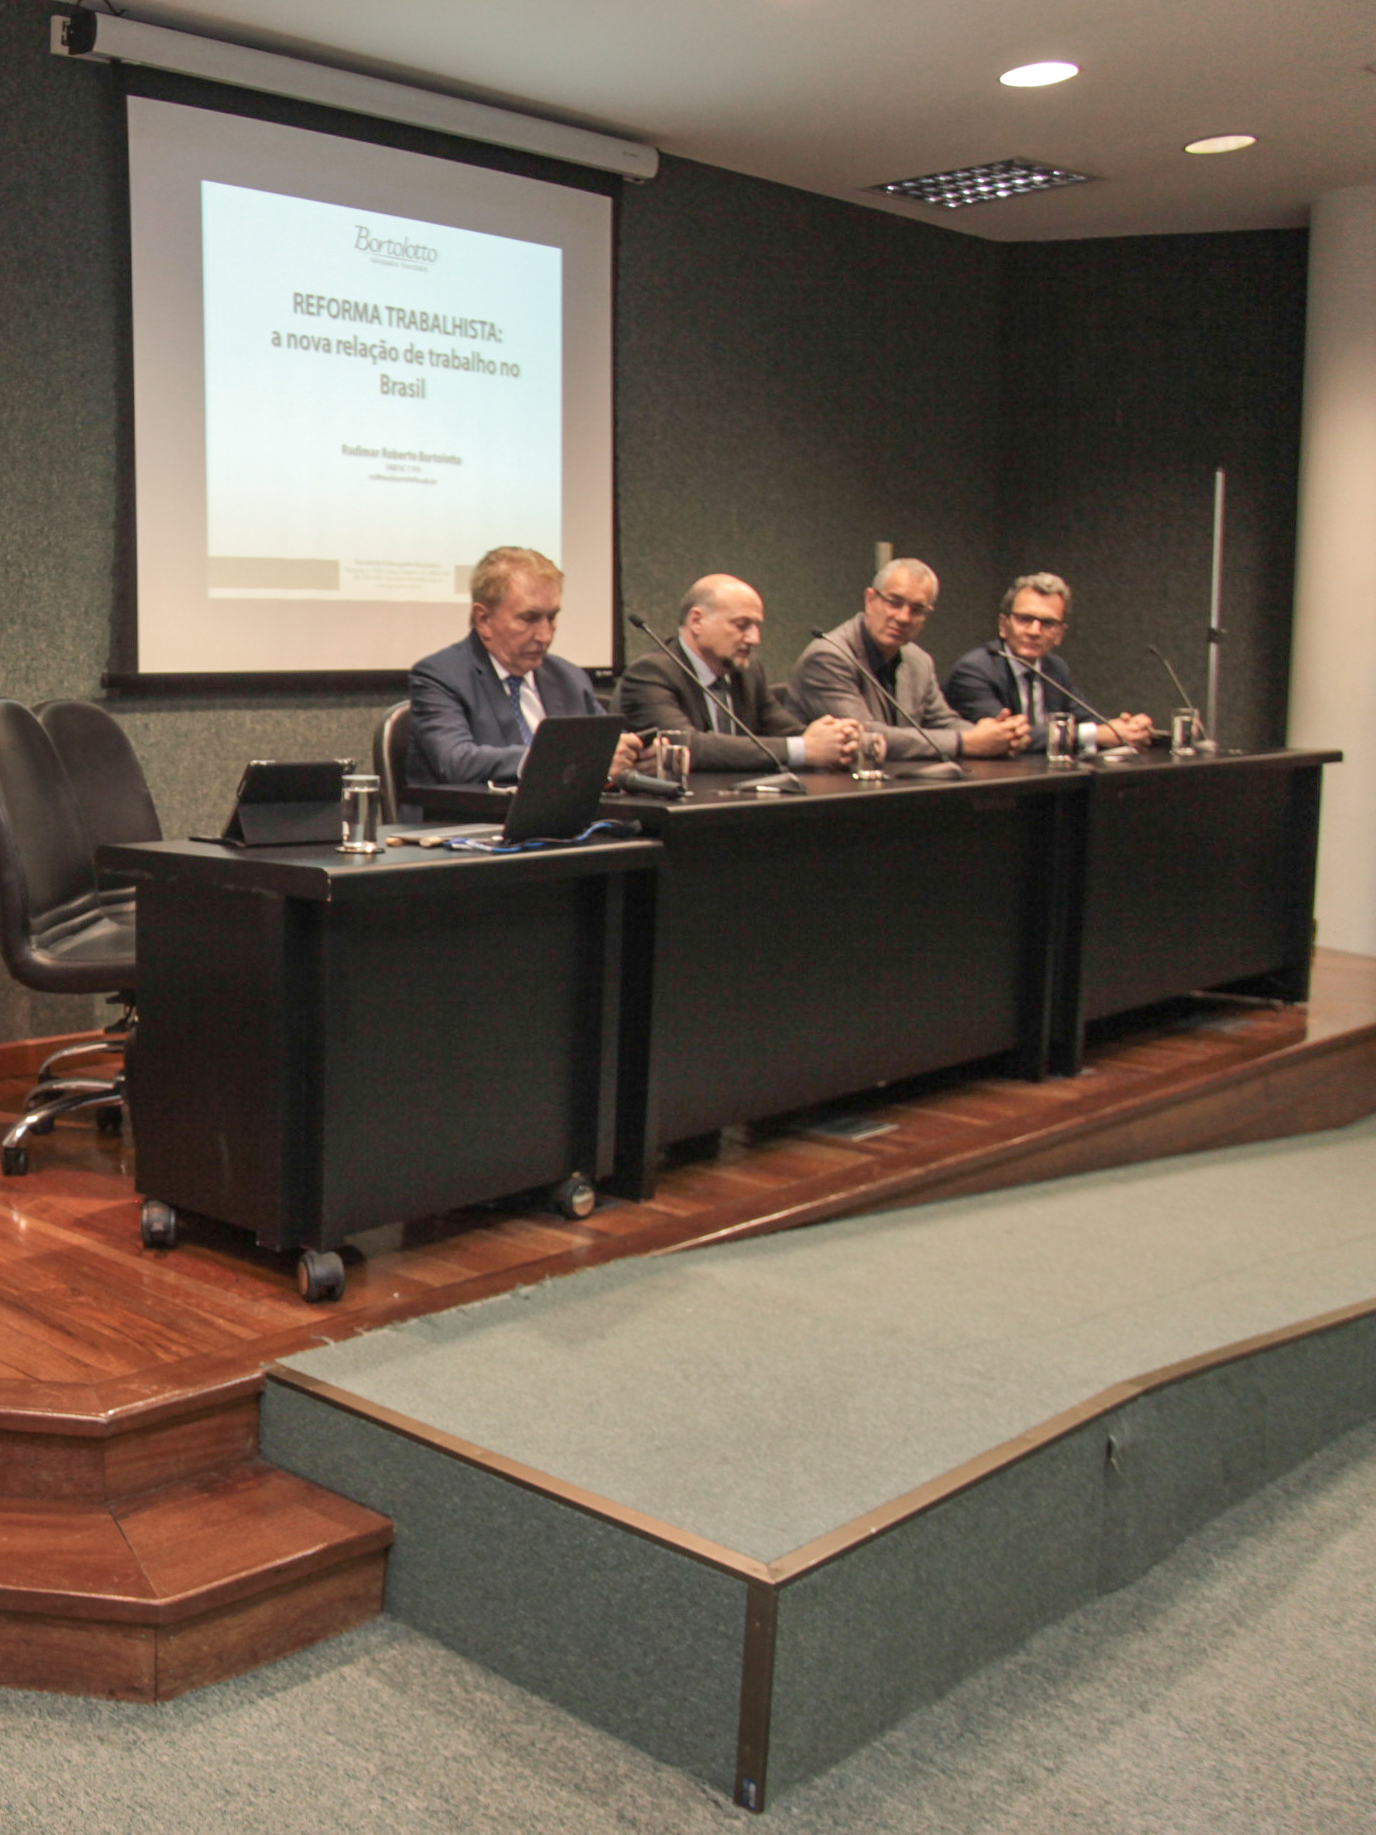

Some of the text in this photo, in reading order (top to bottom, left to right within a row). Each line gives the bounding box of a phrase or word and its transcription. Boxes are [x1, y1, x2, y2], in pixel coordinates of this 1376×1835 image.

[354, 225, 438, 263] Bortolotto
[293, 292, 503, 343] REFORMA TRABALHISTA:
[271, 330, 520, 378] a nova relação de trabalho no
[379, 373, 426, 399] Brasil
[382, 447, 417, 460] Roberto
